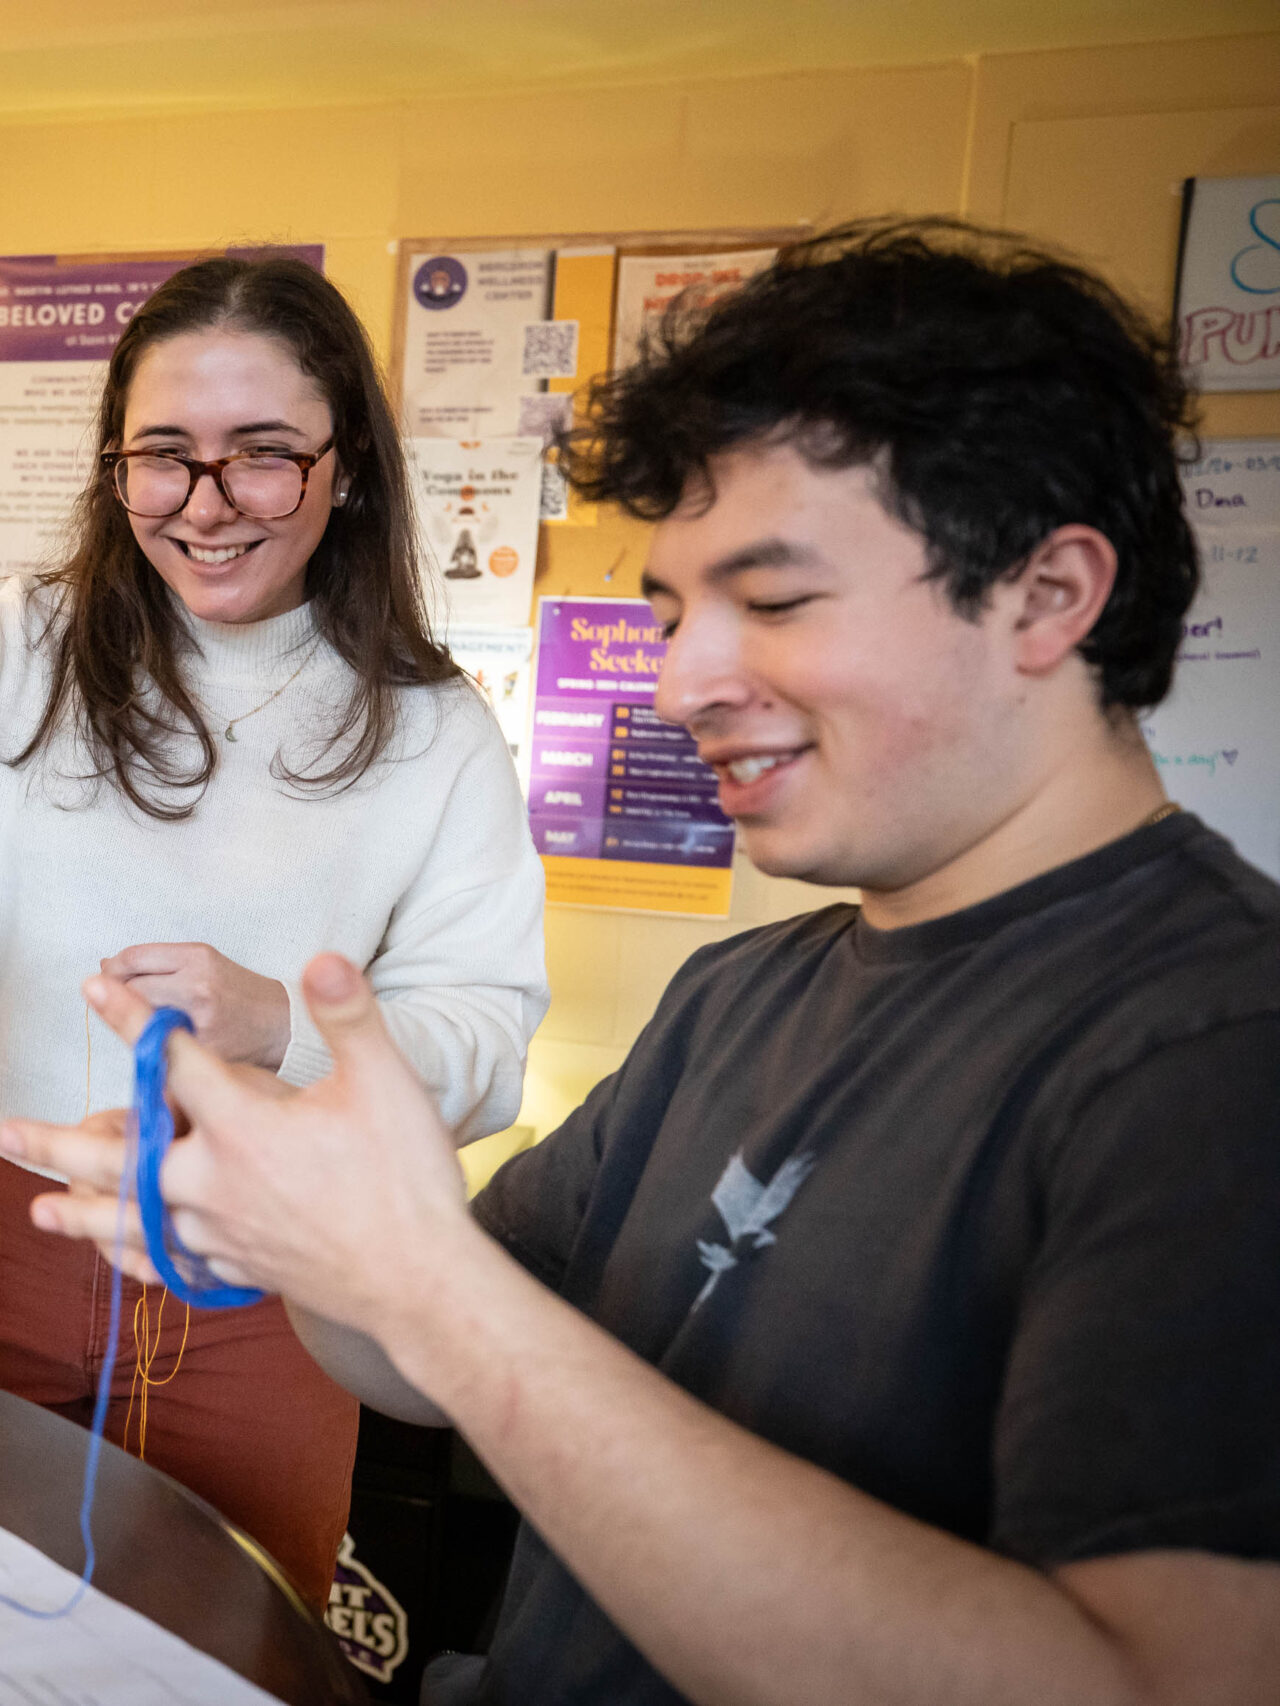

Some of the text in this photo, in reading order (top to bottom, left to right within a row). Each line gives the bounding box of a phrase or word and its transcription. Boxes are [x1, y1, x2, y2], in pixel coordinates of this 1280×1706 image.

[422, 467, 519, 484] Yoga in the
[589, 648, 662, 673] Seeke
[536, 711, 605, 727] FEBRUARY
[540, 751, 593, 766] MARCH
[544, 790, 582, 806] APRIL
[545, 830, 577, 843] MAY
